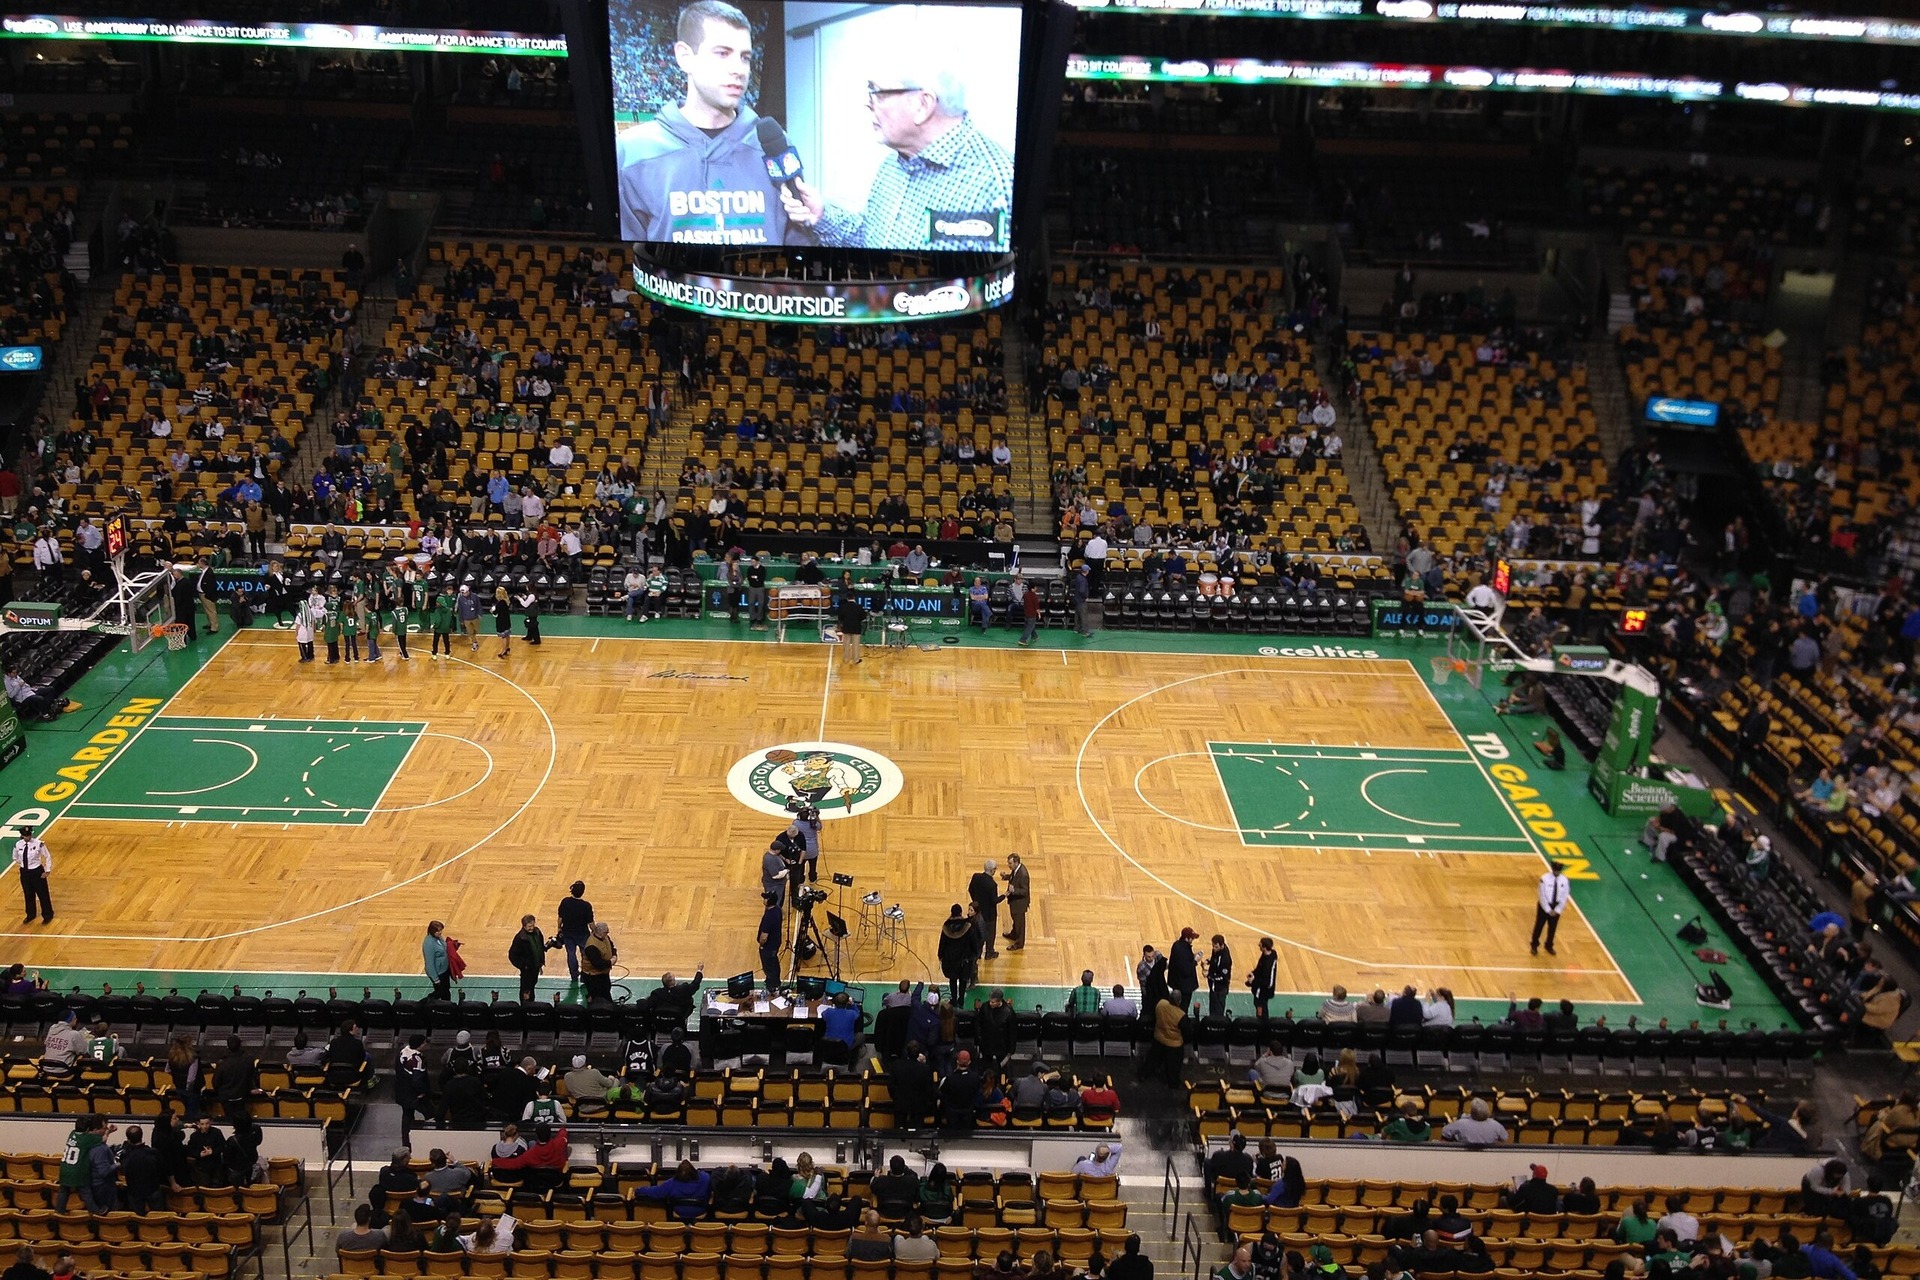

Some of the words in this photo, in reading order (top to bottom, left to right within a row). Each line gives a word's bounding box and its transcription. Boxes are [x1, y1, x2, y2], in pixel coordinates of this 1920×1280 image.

[64, 22, 84, 33] USE
[150, 24, 169, 36] FOR
[169, 25, 176, 36] A
[175, 25, 213, 37] CHANCE
[213, 26, 225, 38] TO
[225, 27, 241, 38] SIT
[241, 27, 291, 39] COURTSIDE
[440, 35, 460, 46] FOR
[460, 36, 467, 46] A
[467, 36, 503, 48] CHANCE
[504, 38, 516, 48] TO
[517, 38, 531, 49] SIT
[669, 190, 765, 216] BOSTON
[672, 228, 767, 245] BASKETBALL
[650, 275, 694, 304] CHANCE
[693, 286, 715, 308] TO
[716, 290, 742, 311] SIT
[743, 293, 846, 317] COURTSIDE
[984, 280, 1002, 302] USE
[110, 530, 123, 553] 24
[917, 599, 941, 612] ANI
[20, 617, 51, 626] OPTUM
[1258, 645, 1380, 659] @celtics
[1571, 659, 1603, 669] OPTUM
[34, 698, 164, 802] GARDEN
[752, 762, 778, 799] BOSTON
[849, 758, 878, 795] CELTICS
[1622, 790, 1679, 804] Scientific
[1631, 782, 1667, 795] Boston
[1467, 732, 1511, 760] TD
[1490, 763, 1600, 880] GARDEN
[629, 1062, 648, 1071] 21
